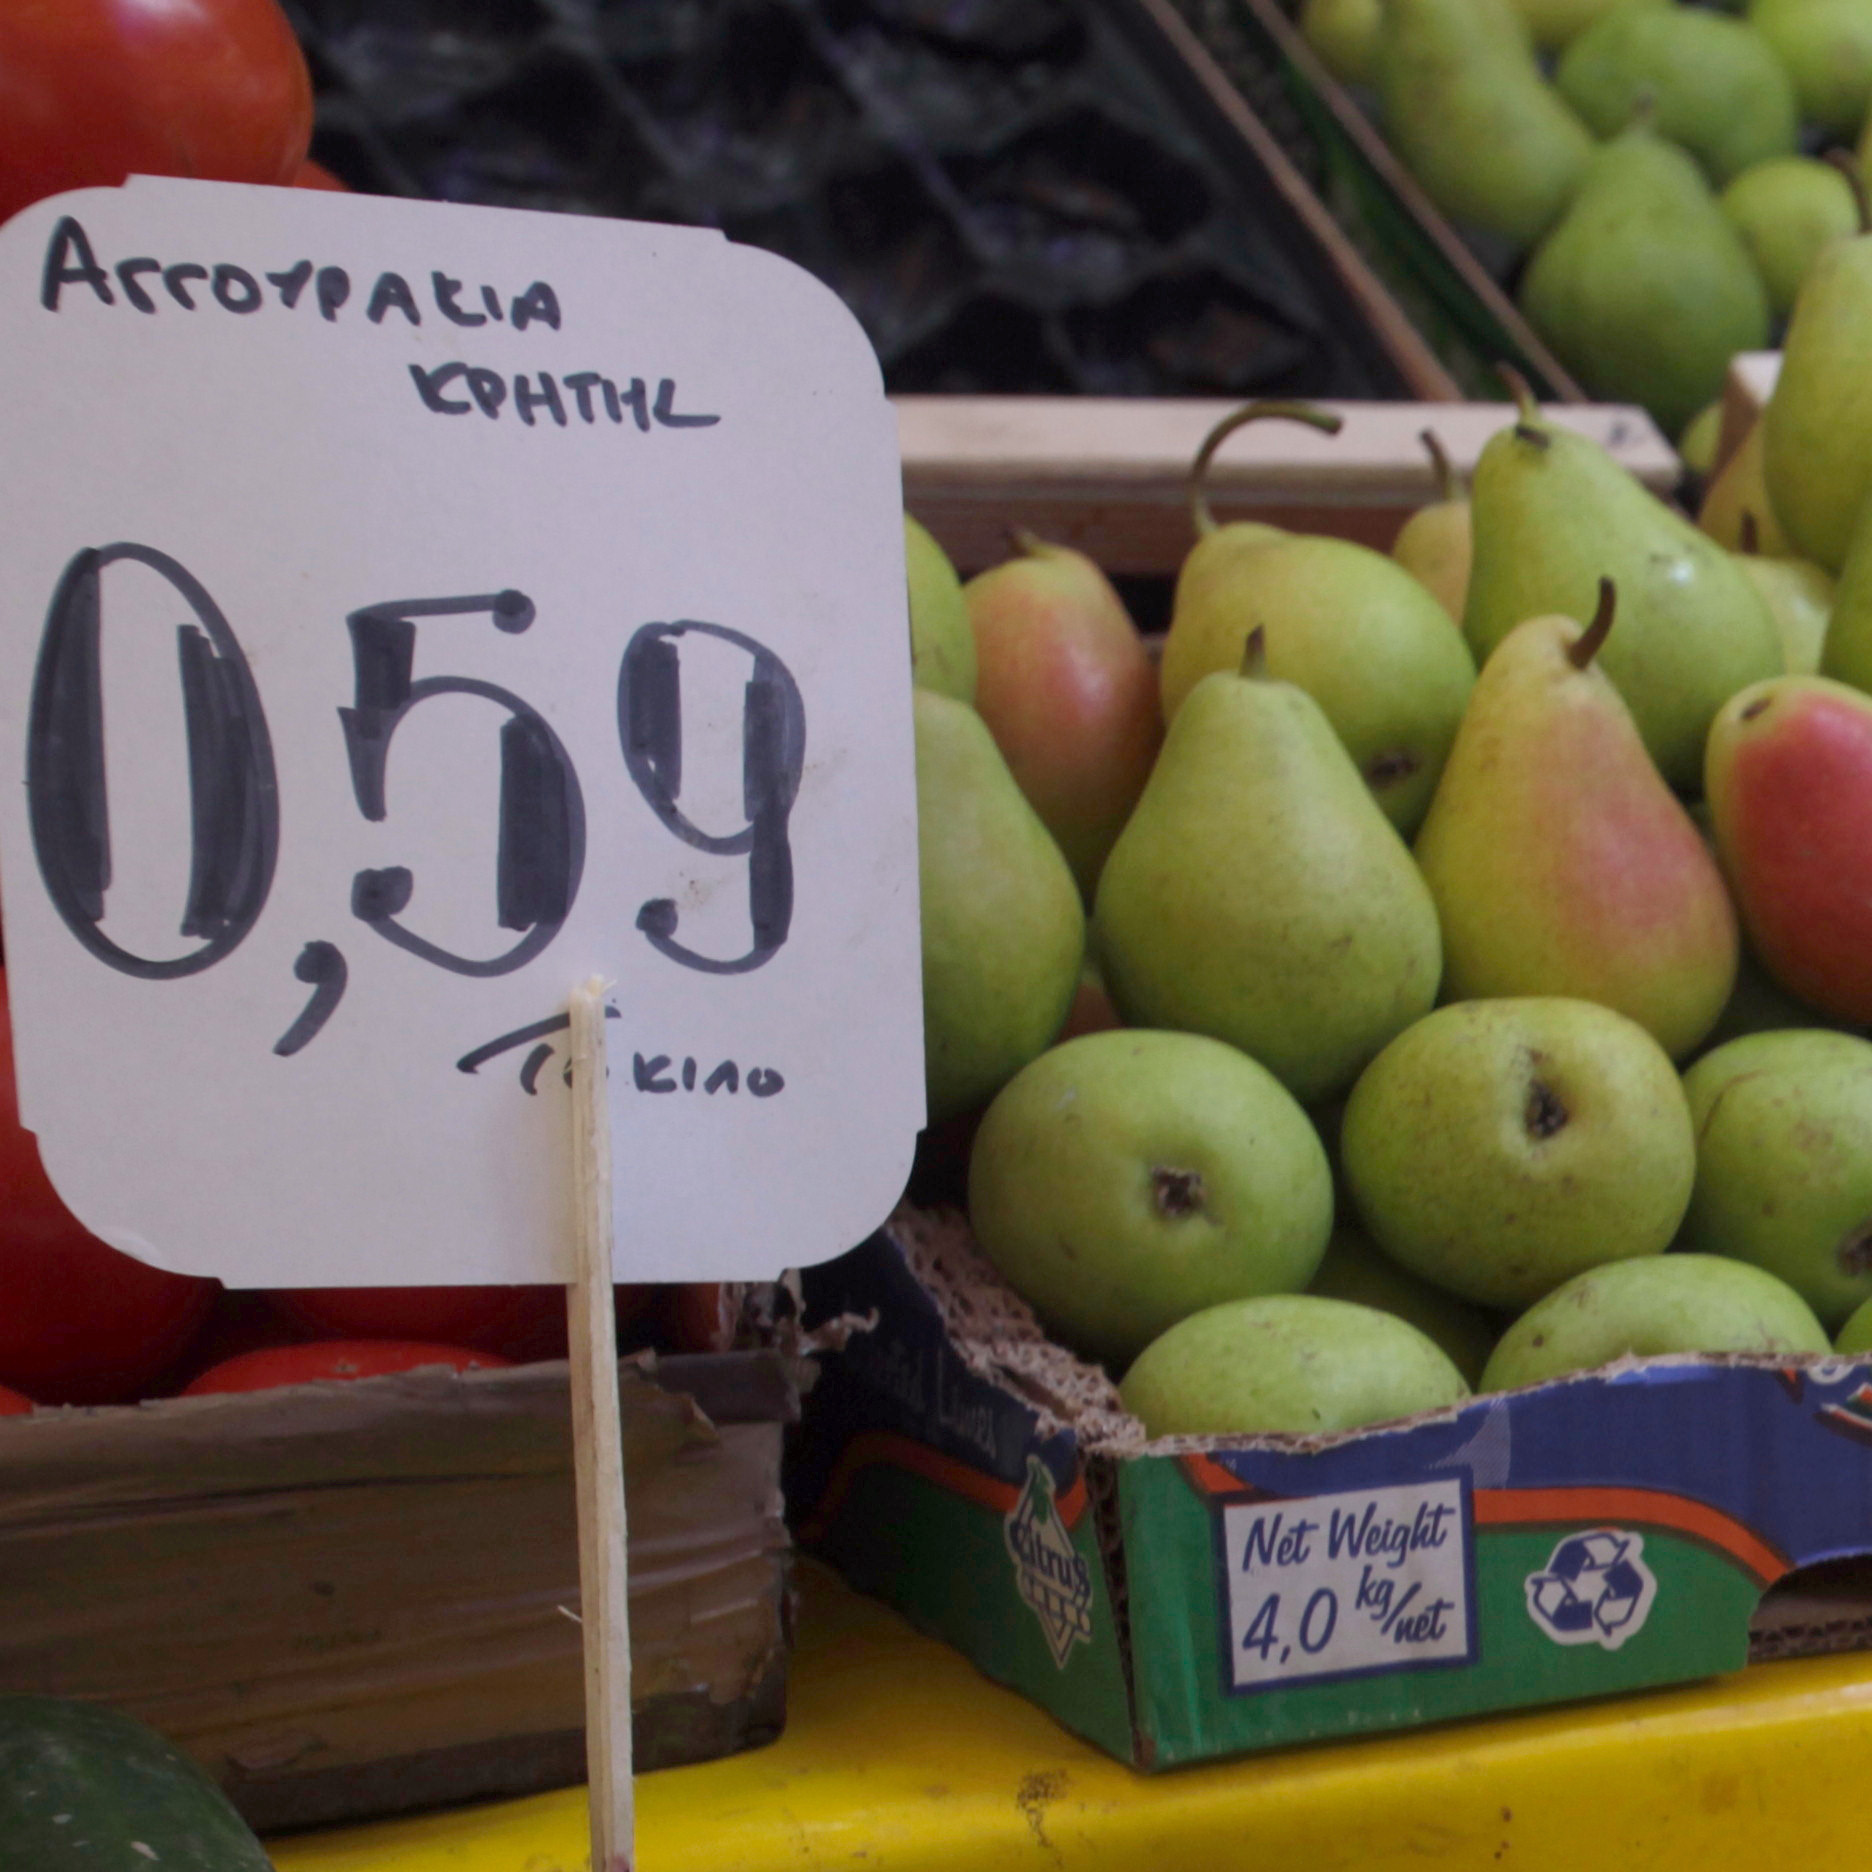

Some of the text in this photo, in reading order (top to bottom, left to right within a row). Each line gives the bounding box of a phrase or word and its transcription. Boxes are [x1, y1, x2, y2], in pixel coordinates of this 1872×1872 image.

[24, 540, 807, 1057] 0,59
[456, 1005, 622, 1096] Τ
[1241, 1500, 1457, 1573] Net Weight
[1241, 1586, 1339, 1665] 4,0
